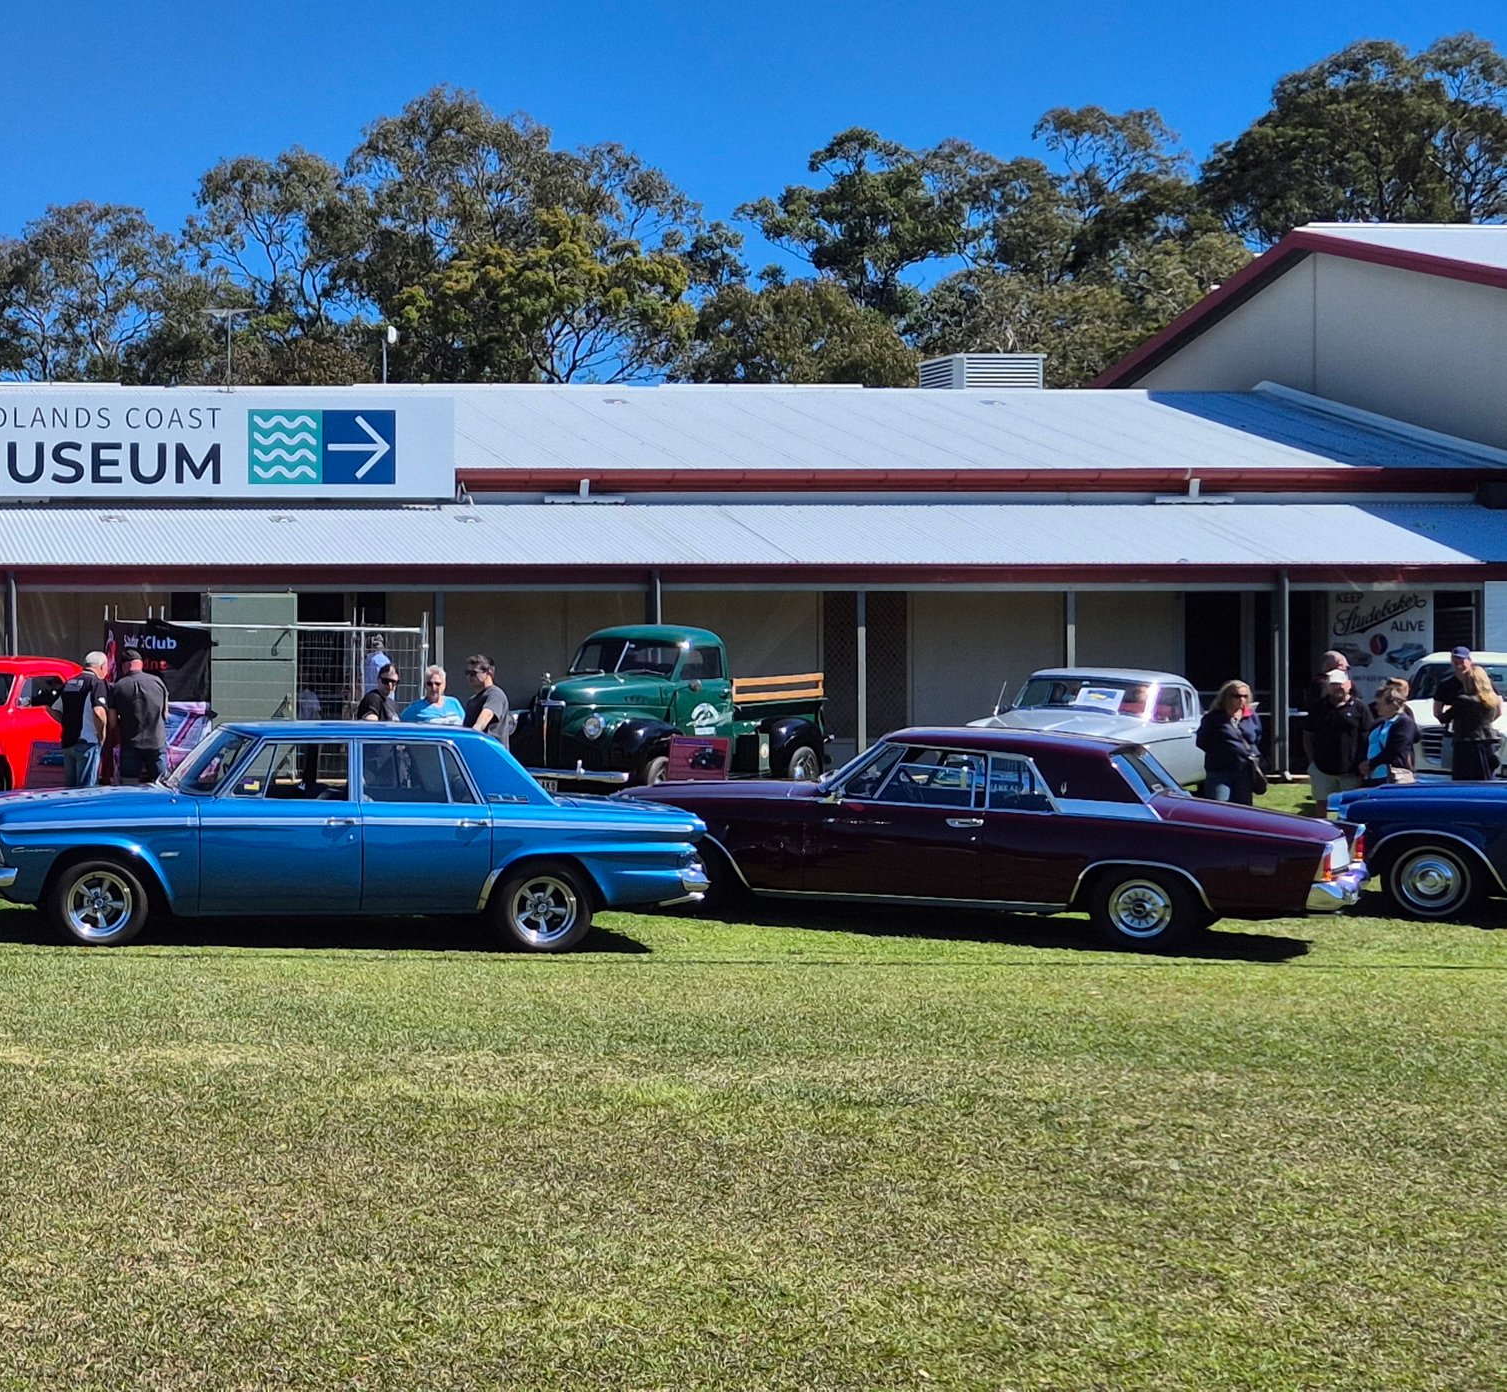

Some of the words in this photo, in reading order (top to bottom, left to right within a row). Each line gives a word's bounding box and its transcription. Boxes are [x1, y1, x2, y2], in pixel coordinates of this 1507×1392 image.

[125, 407, 221, 430] COAST
[1335, 591, 1364, 604] KEEP
[1333, 593, 1427, 636] Studebaker
[1391, 620, 1425, 632] ALIVE
